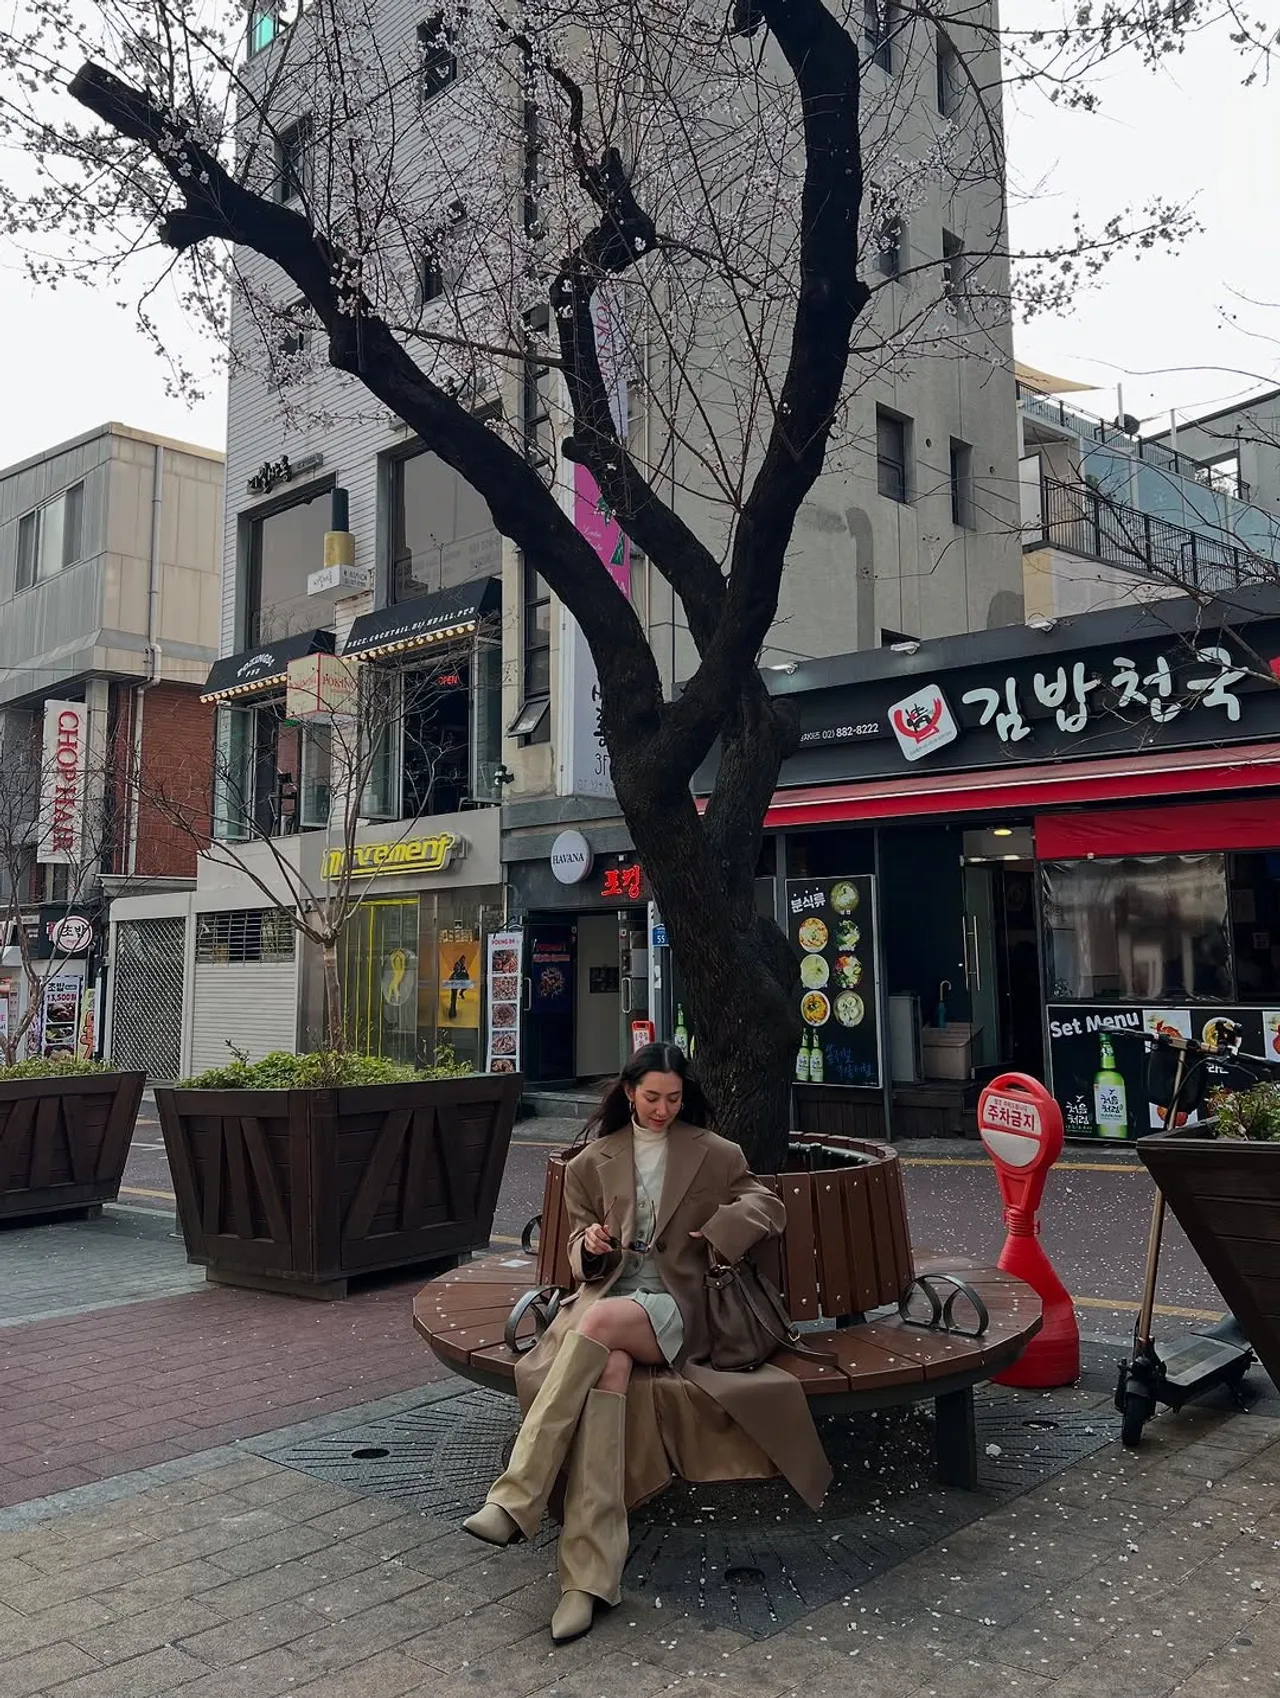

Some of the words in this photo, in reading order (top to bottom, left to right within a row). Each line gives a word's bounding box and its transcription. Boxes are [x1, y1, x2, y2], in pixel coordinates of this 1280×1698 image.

[436, 675, 458, 686] OPEN
[962, 647, 1248, 741] 김밥천국
[836, 722, 880, 738] 882-8222
[56, 711, 80, 782] CHOP
[52, 784, 78, 852] HAIR
[320, 832, 456, 881] mvement
[552, 852, 585, 865] HAVANA
[601, 864, 640, 899] 포킹
[791, 892, 826, 913] 분식류
[656, 934, 666, 944] 55
[1050, 1018, 1083, 1038] Set
[1085, 1012, 1140, 1033] Menu
[987, 1104, 1035, 1132] 주차금지
[1066, 1101, 1088, 1114] 처음
[1067, 1113, 1090, 1125] 처럼
